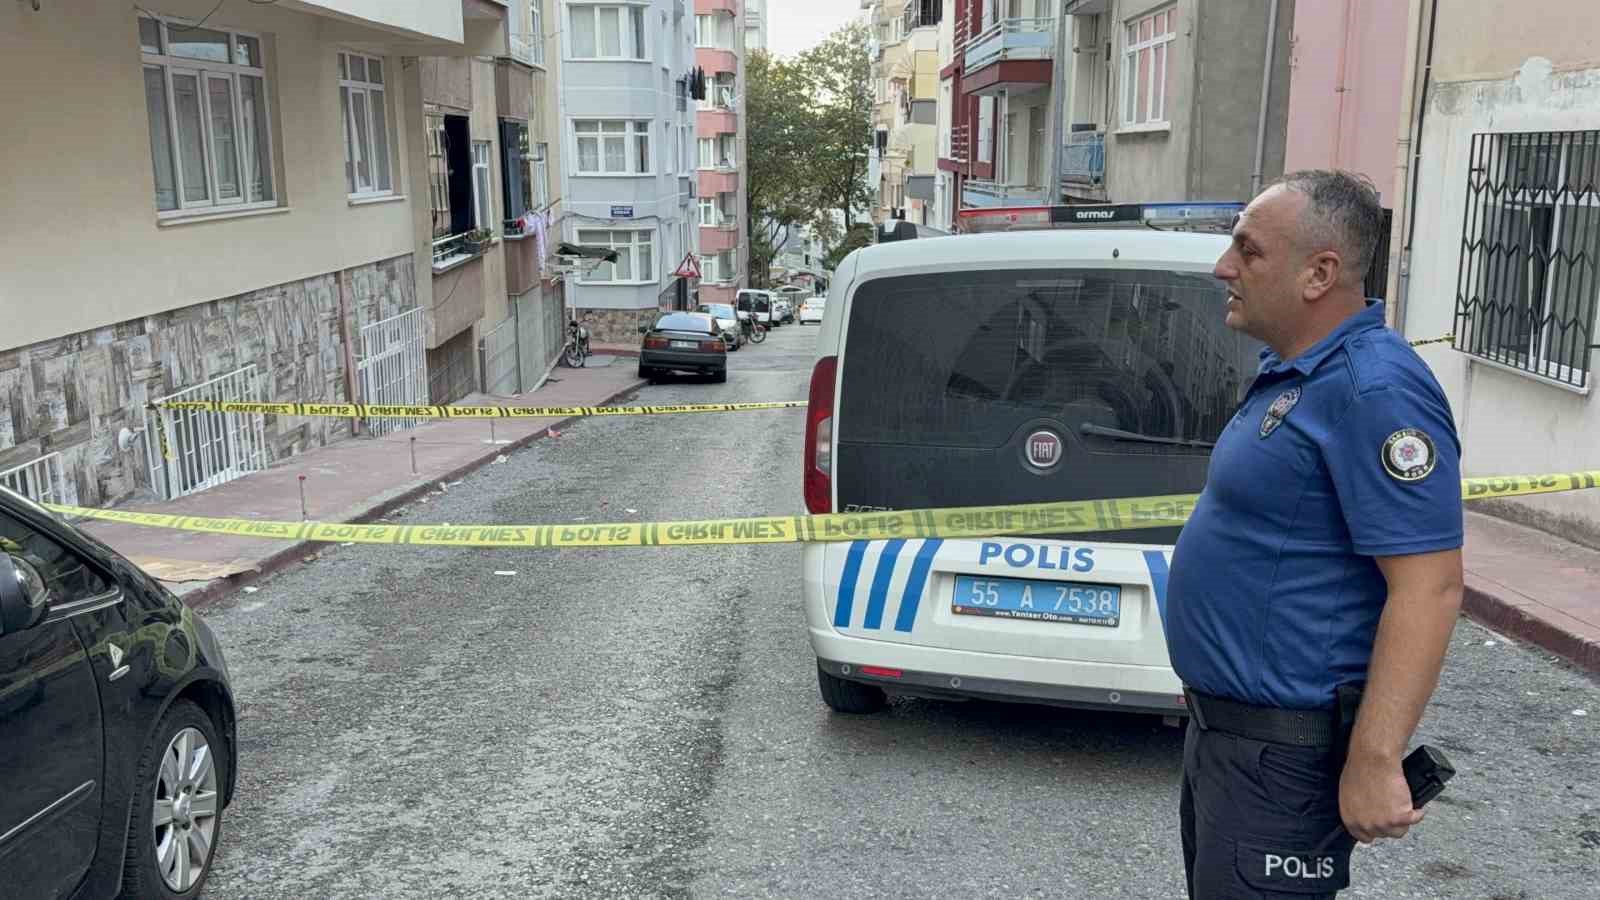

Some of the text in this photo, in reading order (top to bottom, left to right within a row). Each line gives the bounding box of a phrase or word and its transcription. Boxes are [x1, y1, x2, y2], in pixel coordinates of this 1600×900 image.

[1076, 210, 1115, 219] armas
[1033, 441, 1055, 459] FIAT
[971, 581, 1114, 616] 55 A 7538
